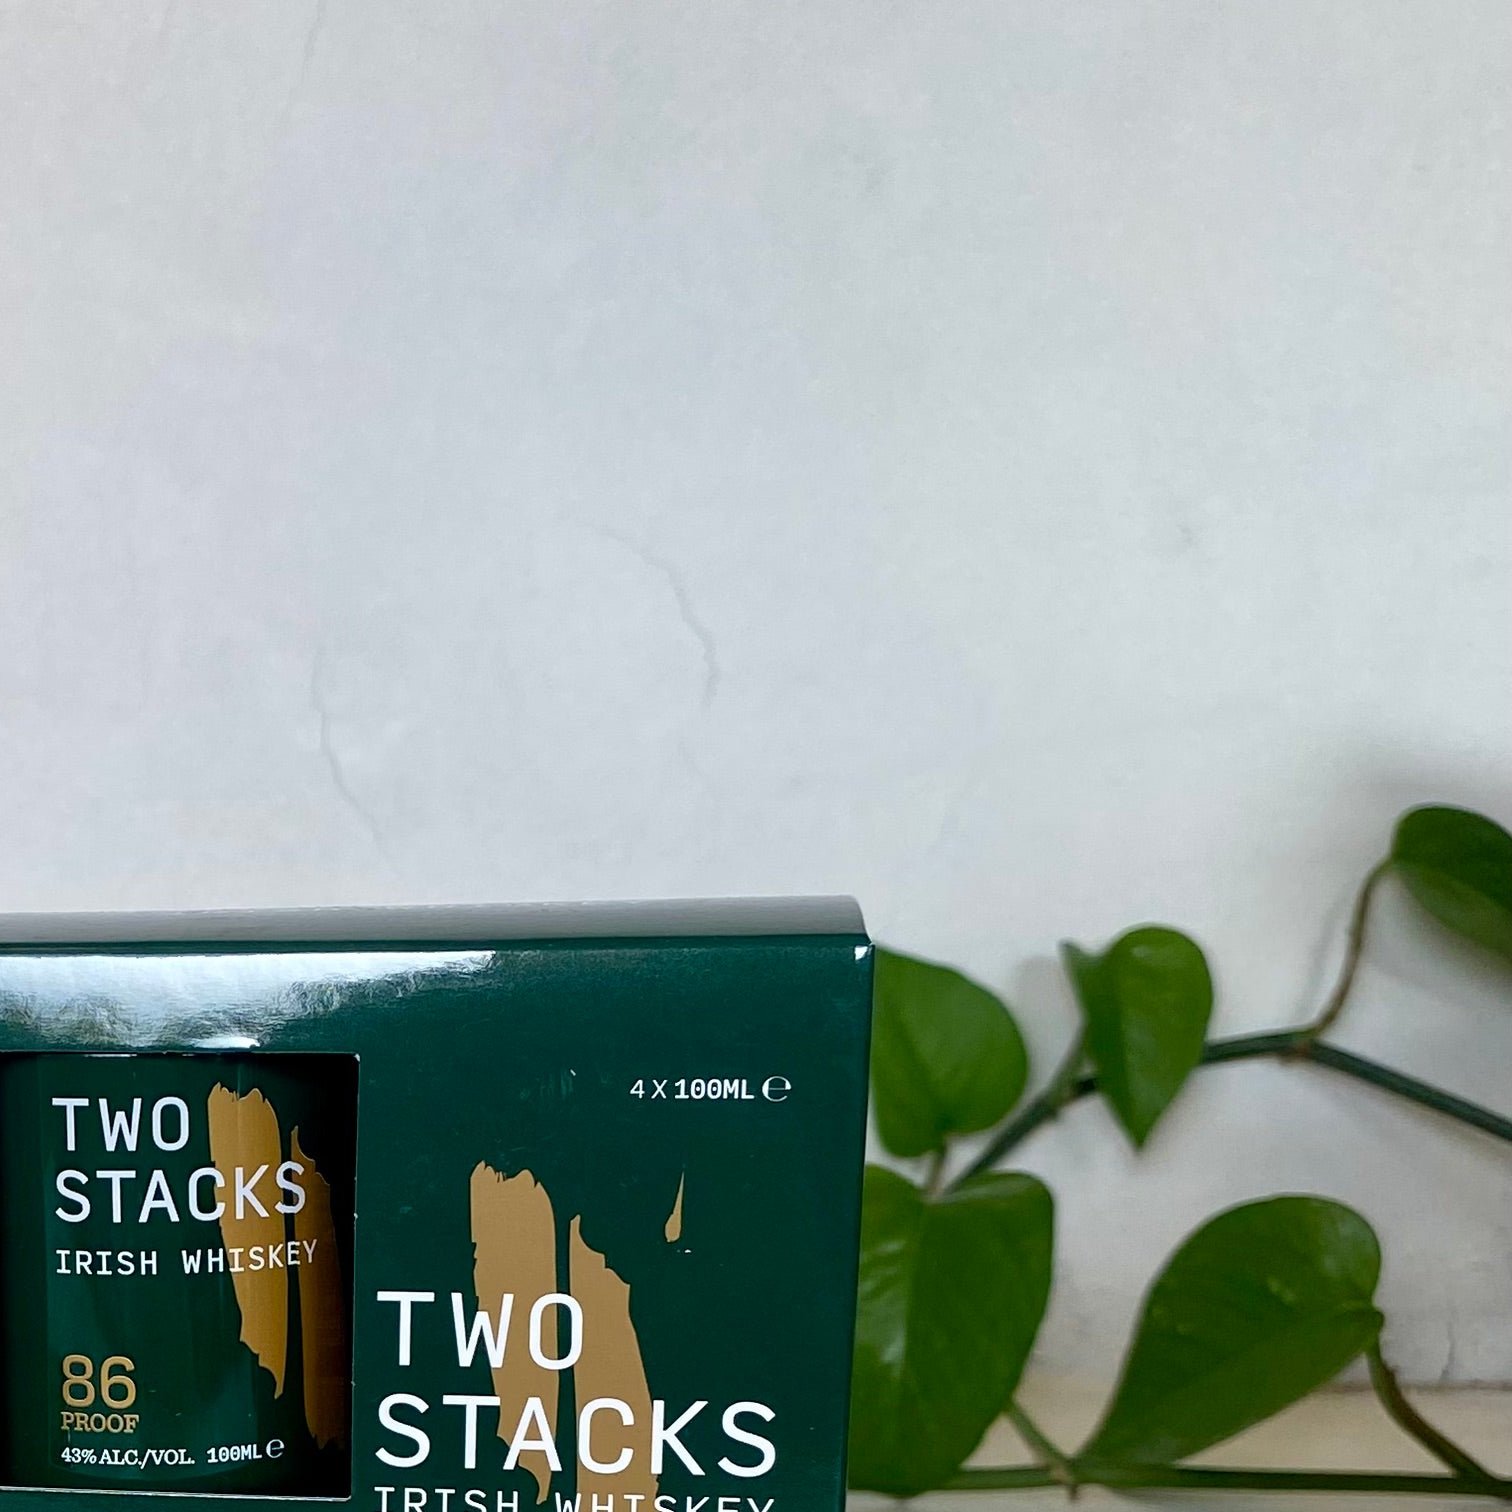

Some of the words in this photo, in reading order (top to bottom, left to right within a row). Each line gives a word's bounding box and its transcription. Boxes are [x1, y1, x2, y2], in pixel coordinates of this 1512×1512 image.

[629, 1079, 645, 1099] 4
[651, 1079, 668, 1099] X
[674, 1078, 755, 1100] 100ML
[51, 1096, 190, 1152] TWO
[55, 1160, 306, 1224] STACKS
[55, 1249, 157, 1276] IRISH
[181, 1239, 318, 1275] WHISKEY
[376, 1290, 584, 1371] TWO
[62, 1354, 137, 1409] 86
[60, 1411, 140, 1434] PROOF
[375, 1393, 776, 1478] STACKS
[206, 1443, 263, 1464] 100ML
